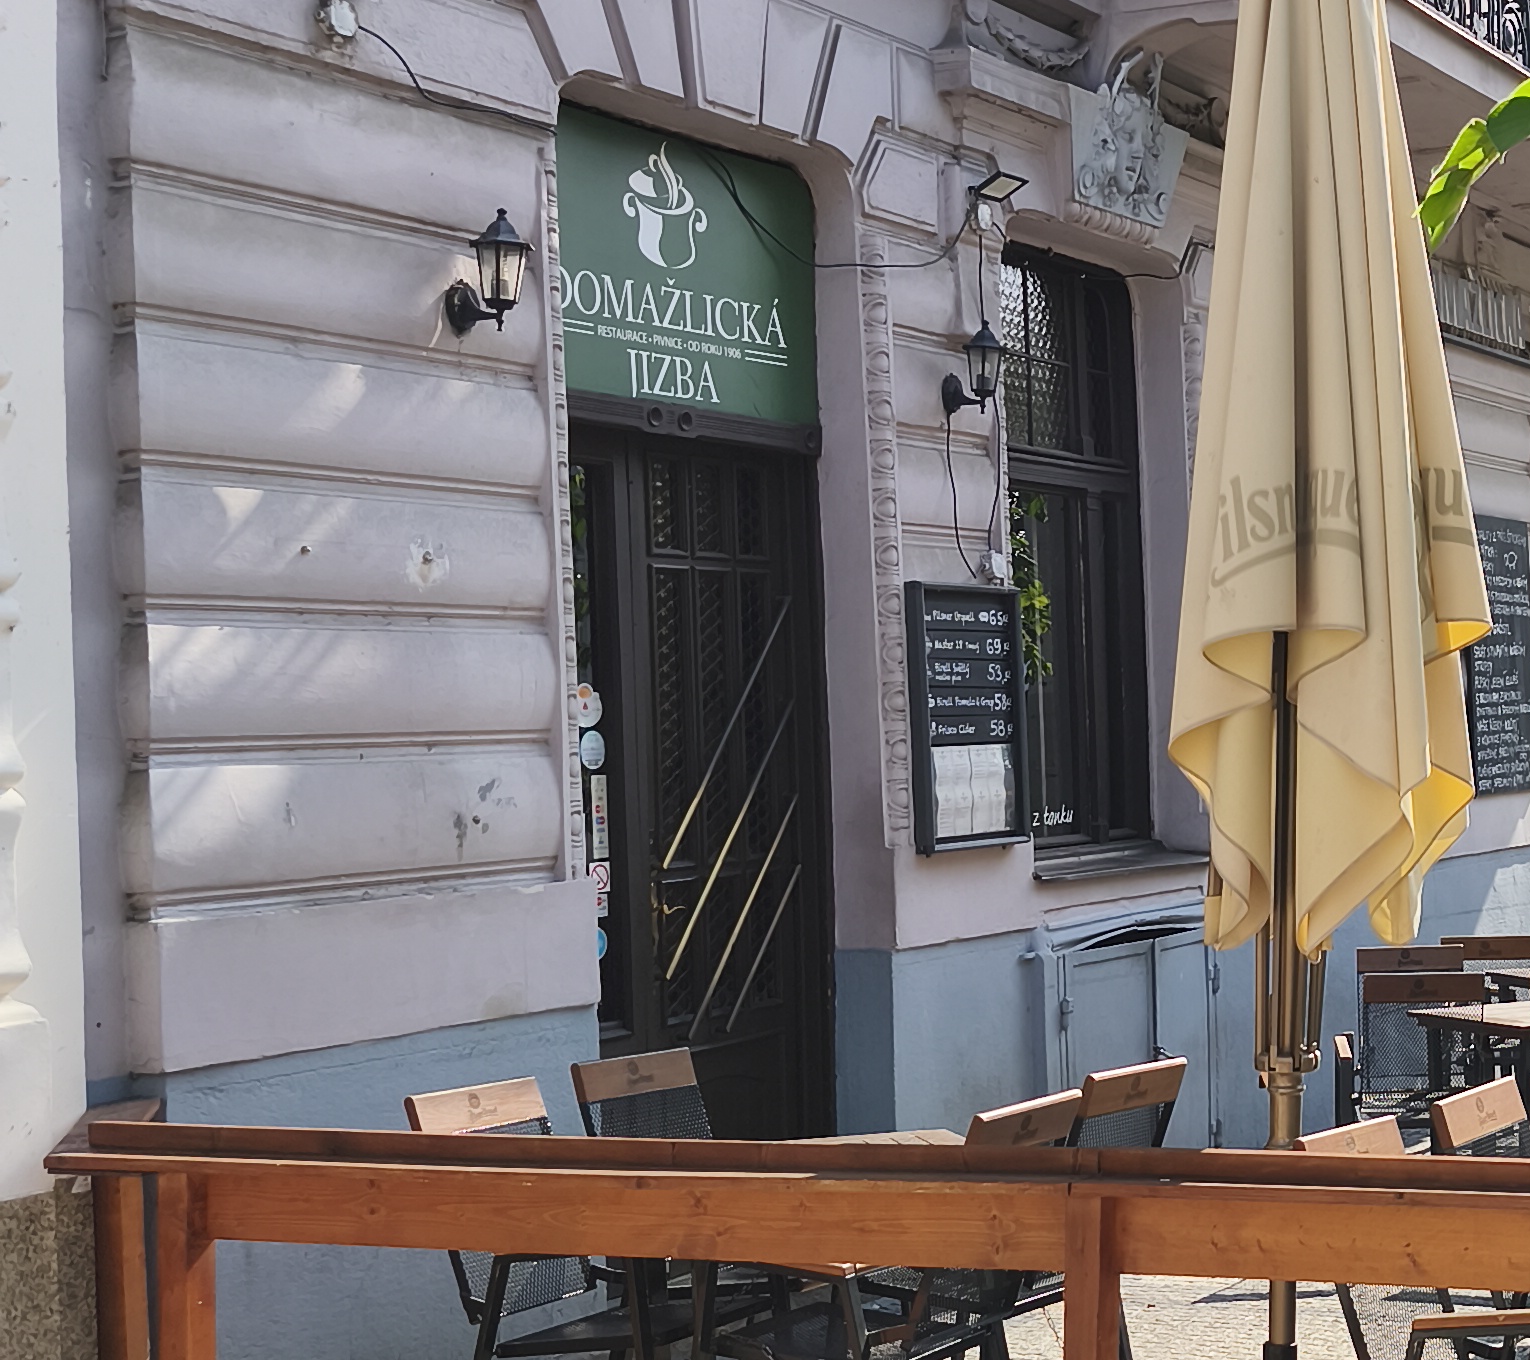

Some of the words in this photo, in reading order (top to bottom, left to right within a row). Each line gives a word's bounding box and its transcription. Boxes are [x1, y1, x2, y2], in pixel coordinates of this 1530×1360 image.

[597, 324, 648, 344] RESTAURACE
[653, 334, 682, 350] PIVNICE
[687, 340, 701, 352] OD
[701, 342, 723, 356] ROKU
[723, 346, 742, 359] 1906
[627, 348, 720, 403] JIZBA
